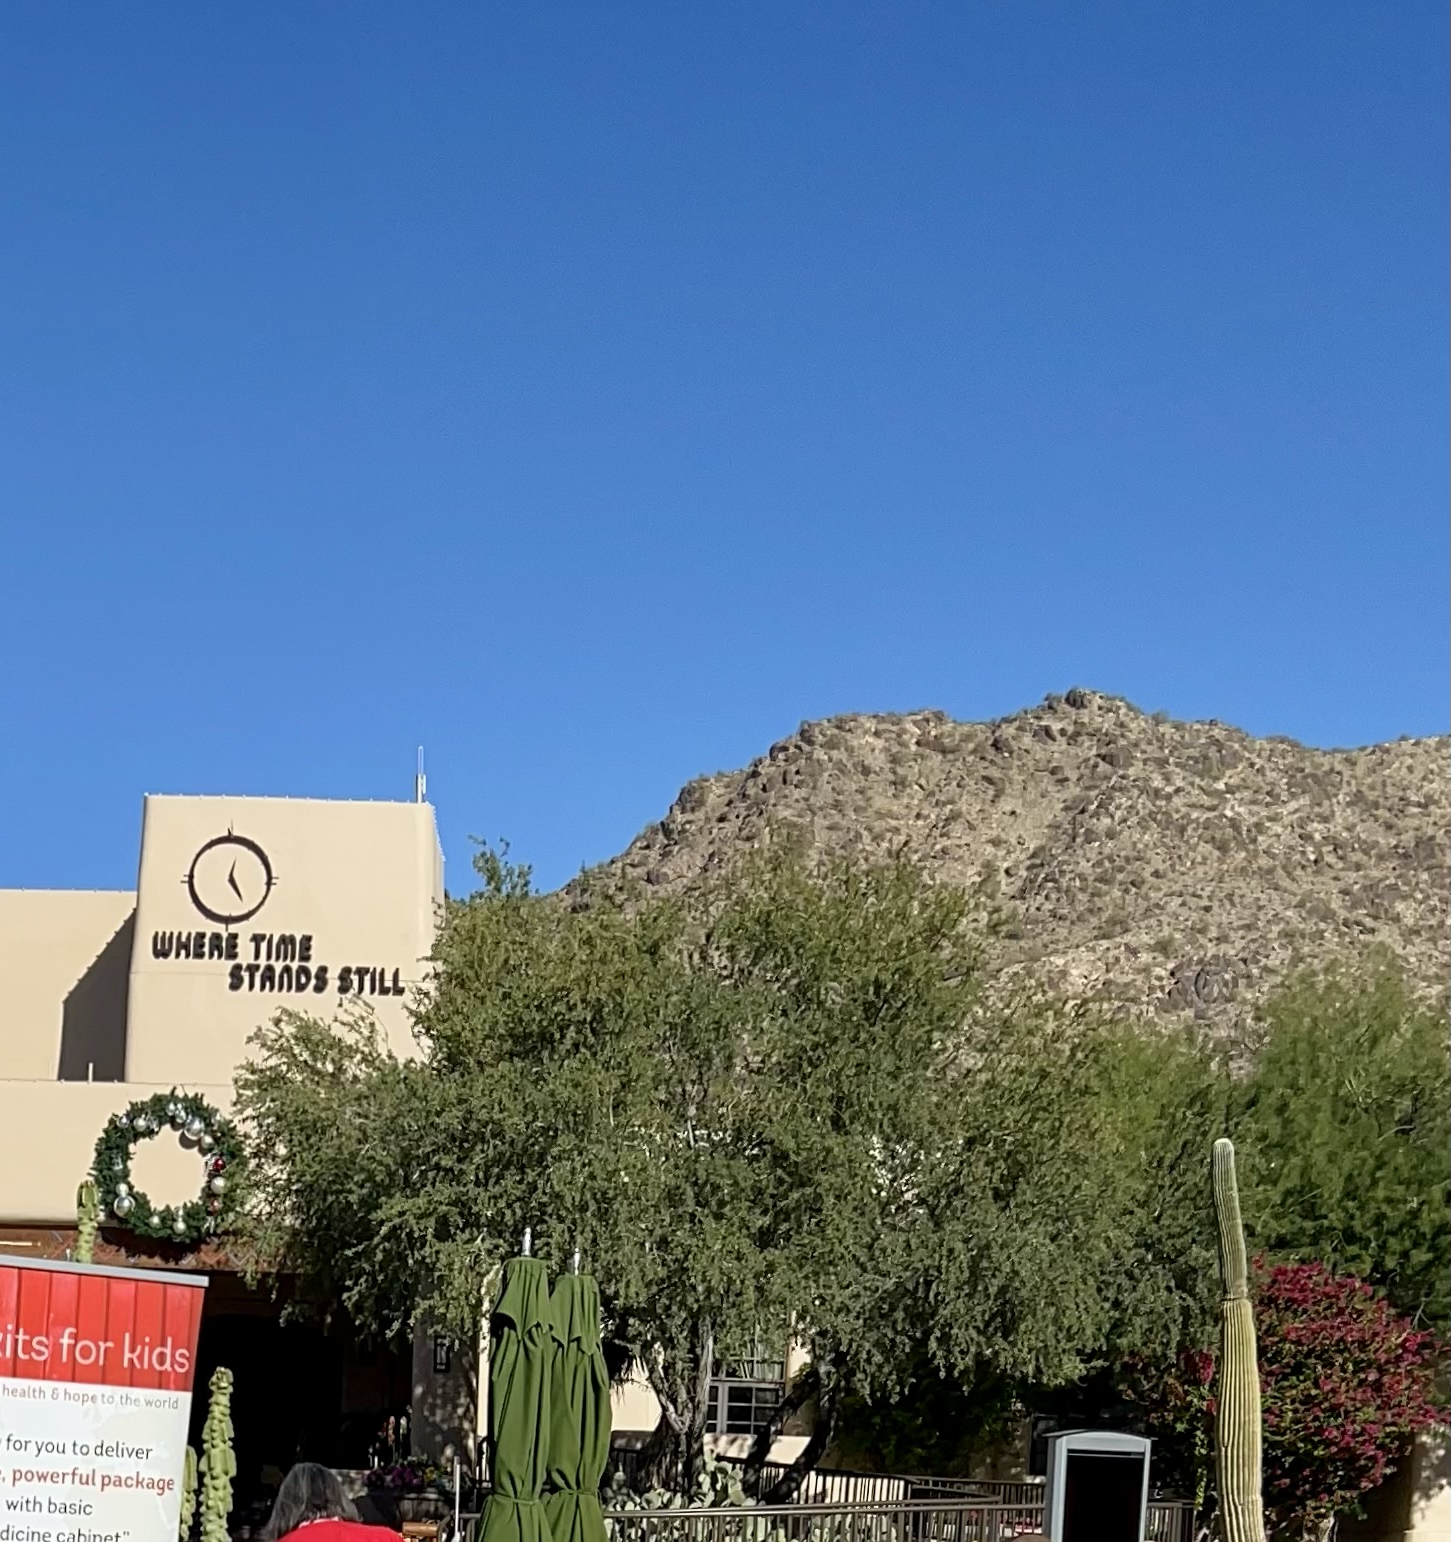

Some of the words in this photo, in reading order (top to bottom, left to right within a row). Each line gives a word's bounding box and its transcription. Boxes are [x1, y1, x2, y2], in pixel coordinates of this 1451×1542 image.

[152, 930, 239, 960] WHERE
[249, 932, 313, 962] TIME
[228, 963, 329, 995] STANDS
[337, 966, 406, 997] STILL
[58, 1326, 115, 1367] for
[122, 1333, 191, 1375] kids
[2, 1383, 46, 1401] health
[63, 1390, 98, 1406] hope
[100, 1392, 116, 1405] to
[119, 1393, 142, 1408] the
[144, 1396, 180, 1411] world
[5, 1433, 32, 1452] for
[34, 1440, 67, 1457] you
[72, 1438, 91, 1457] to
[93, 1442, 153, 1461] deliver
[11, 1466, 98, 1488] powerful
[100, 1474, 176, 1496] package
[5, 1496, 44, 1514] with
[47, 1498, 94, 1516] basic
